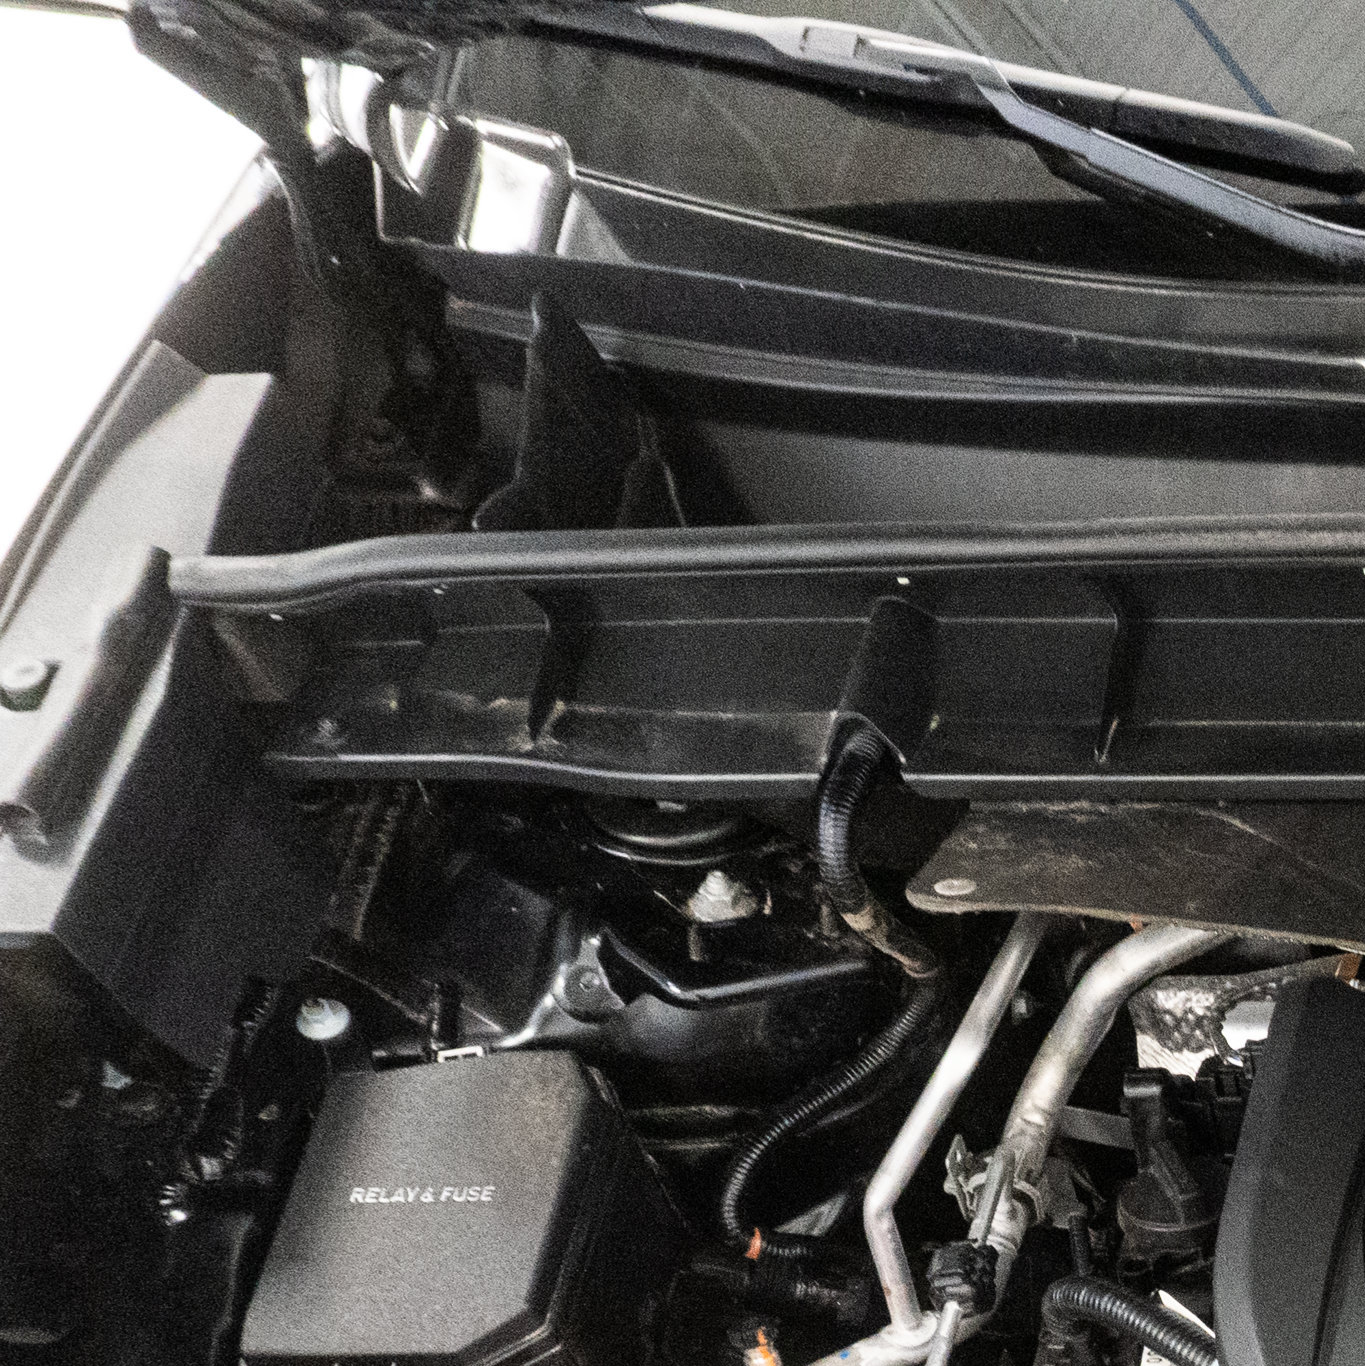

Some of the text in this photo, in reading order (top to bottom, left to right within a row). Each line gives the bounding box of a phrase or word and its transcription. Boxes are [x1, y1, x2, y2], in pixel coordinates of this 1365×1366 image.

[349, 1186, 496, 1203] RELAY & FUSE
